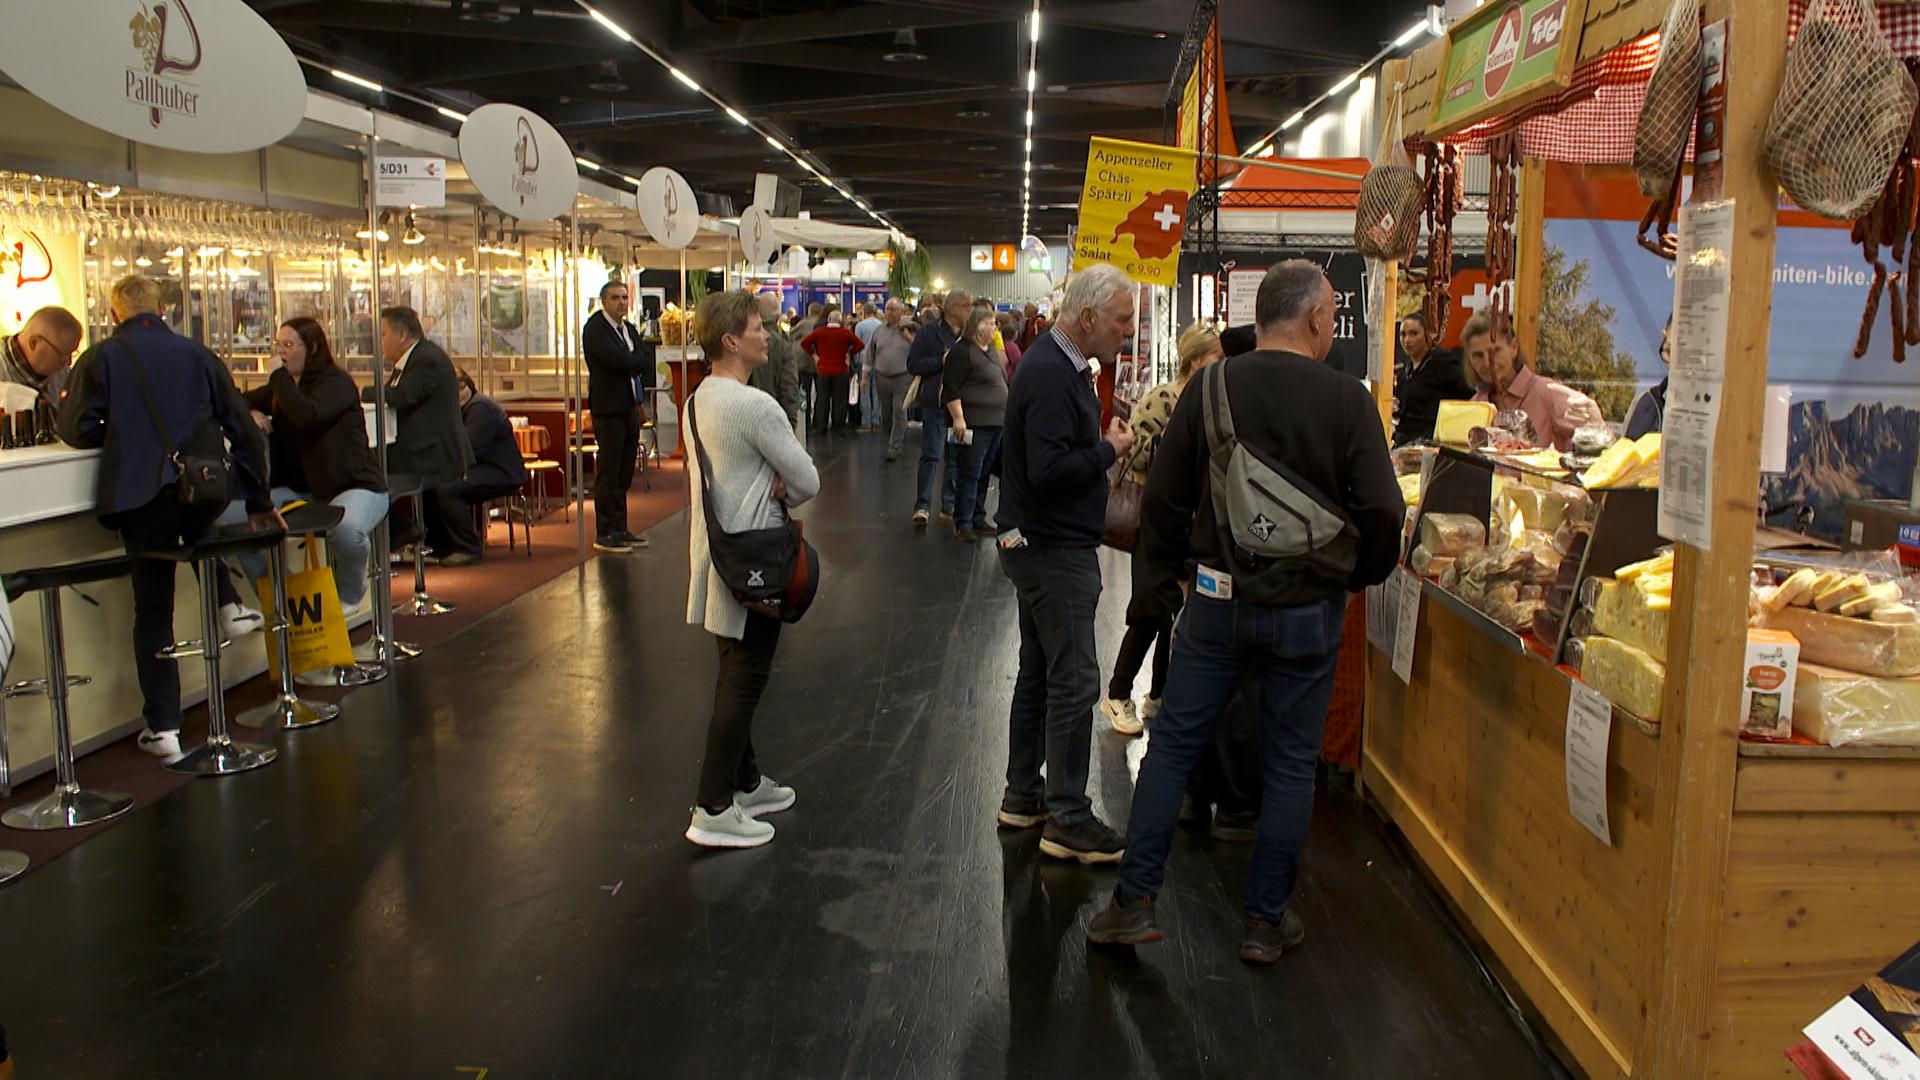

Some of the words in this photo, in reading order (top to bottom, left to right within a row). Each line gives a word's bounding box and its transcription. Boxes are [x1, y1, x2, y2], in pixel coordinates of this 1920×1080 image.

[125, 69, 199, 114] Pallhuber
[379, 162, 409, 175] 5/D31
[1094, 149, 1174, 172] Appenzeller
[1098, 169, 1135, 184] Chäs-
[1088, 185, 1132, 202] Spätzli
[1082, 235, 1099, 244] mit
[999, 247, 1009, 267] 4
[1079, 245, 1111, 261] Salat
